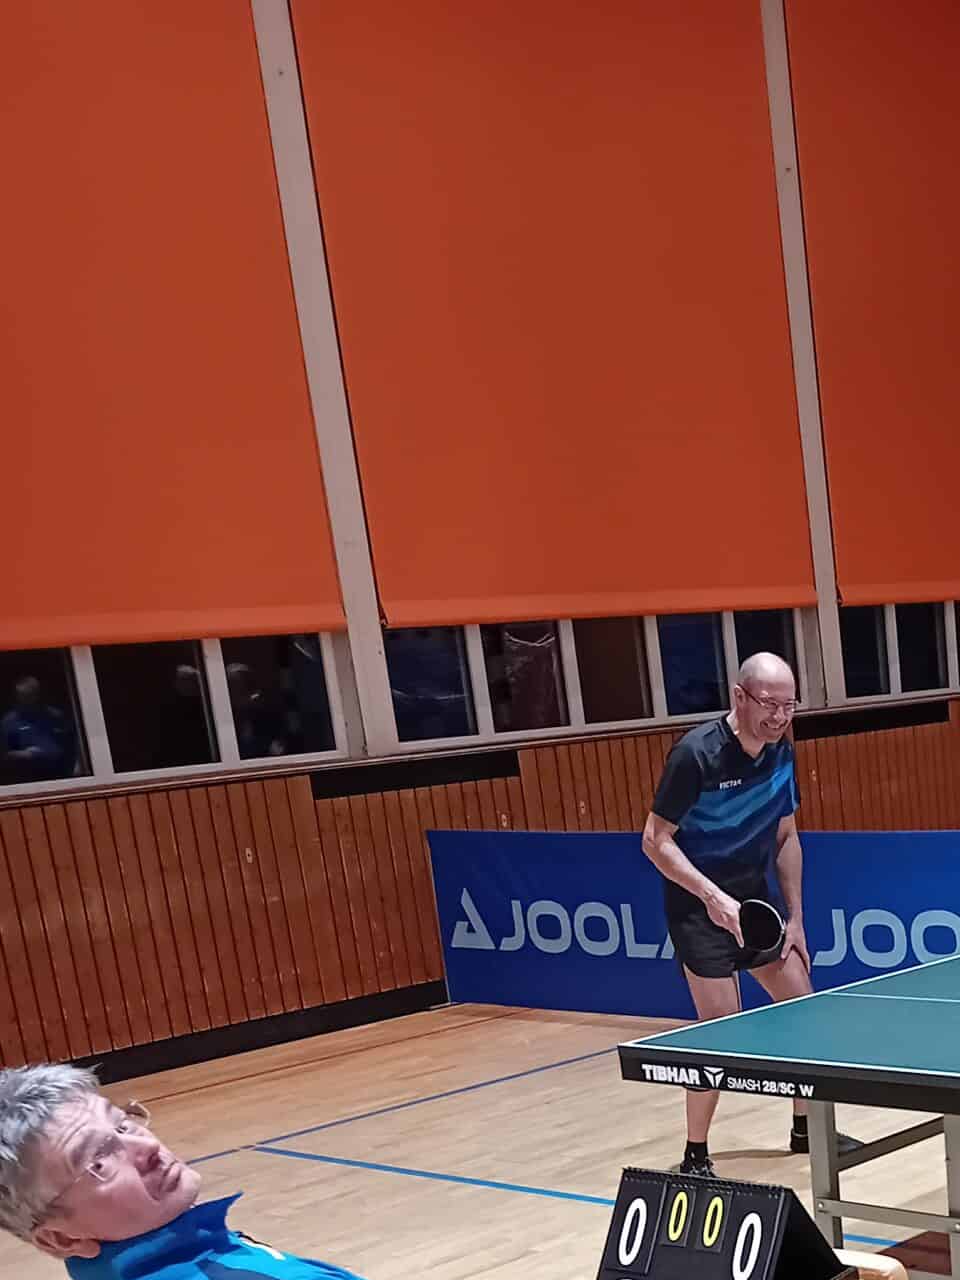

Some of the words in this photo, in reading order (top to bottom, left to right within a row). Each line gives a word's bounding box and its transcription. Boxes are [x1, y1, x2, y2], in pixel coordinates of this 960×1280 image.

[641, 1063, 701, 1086] TIBHAR
[726, 1076, 761, 1092] SMASH
[762, 1080, 796, 1095] 28/SC
[799, 1083, 814, 1097] W
[618, 1197, 648, 1267] 0
[667, 1191, 688, 1242] 0
[702, 1196, 724, 1248] 0
